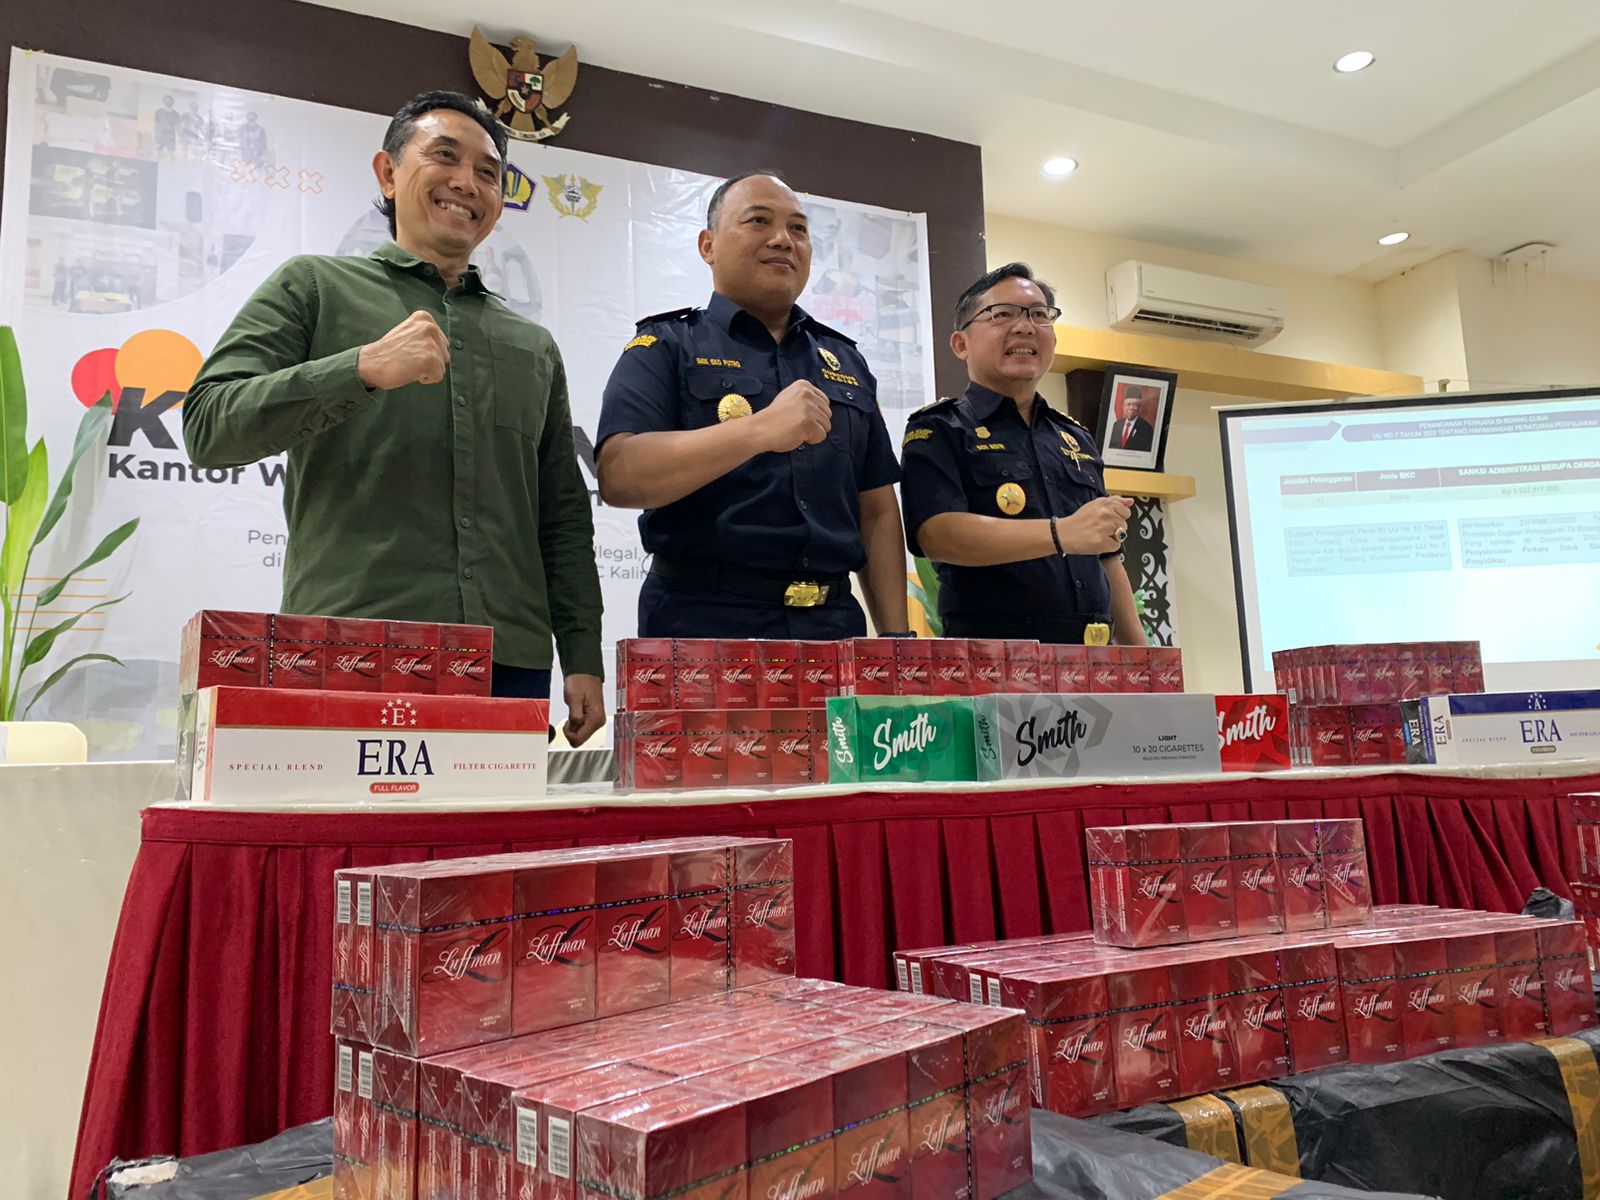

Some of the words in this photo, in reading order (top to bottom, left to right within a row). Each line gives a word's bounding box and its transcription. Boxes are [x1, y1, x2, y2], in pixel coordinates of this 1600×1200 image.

[109, 453, 246, 485] Kantor
[1284, 477, 1309, 485] Jumlah
[1310, 475, 1353, 484] Pelanggaran
[1458, 468, 1487, 476] SANKSI
[1488, 465, 1540, 475] ADMINISTRASI
[1541, 462, 1572, 471] BERUPA
[263, 553, 281, 567] di
[208, 650, 255, 668] Luffman
[273, 652, 317, 670] Luffman
[333, 655, 375, 672] Luffman
[391, 657, 432, 675] Luffman
[447, 660, 486, 677] Luffman
[392, 708, 406, 726] E
[832, 716, 853, 764] Smith
[873, 712, 937, 771] Smith
[979, 714, 997, 761] Smith
[1015, 709, 1088, 767] Smith
[1433, 715, 1447, 745] ERA
[1520, 719, 1563, 743] ERA
[357, 739, 435, 776] ERA
[1148, 745, 1158, 753] 20
[1159, 744, 1205, 752] CIGARETTES
[229, 763, 281, 771] SPECIAL
[287, 763, 324, 771] BLEND
[453, 763, 486, 771] FILTER
[374, 784, 390, 792] FULL
[391, 783, 417, 792] FLAVOR
[1191, 872, 1227, 895] Luffman
[1240, 869, 1276, 891] Luffman
[1288, 867, 1321, 888] Luffman
[1332, 863, 1365, 884] Luffman
[1138, 876, 1177, 899] Luffman
[680, 909, 728, 940] Luffman
[745, 899, 787, 928] Luffman
[608, 919, 661, 951] Luffman
[526, 931, 586, 965] Luffman
[433, 944, 502, 981] Luffman
[1508, 975, 1543, 998] Luffman
[1554, 968, 1584, 991] Luffman
[1408, 988, 1445, 1012] Luffman
[1458, 982, 1494, 1006] Luffman
[1242, 1003, 1284, 1030] Luffman
[1297, 994, 1336, 1021] Luffman
[1353, 994, 1393, 1019] Luffman
[1122, 1023, 1167, 1051] Luffman
[1184, 1013, 1227, 1041] Luffman
[1055, 1033, 1104, 1064] Luffman
[983, 1088, 1021, 1128] Luffman
[920, 1112, 966, 1155] Luffman
[848, 1138, 902, 1186] Luffman
[767, 1171, 825, 1200] Luffman
